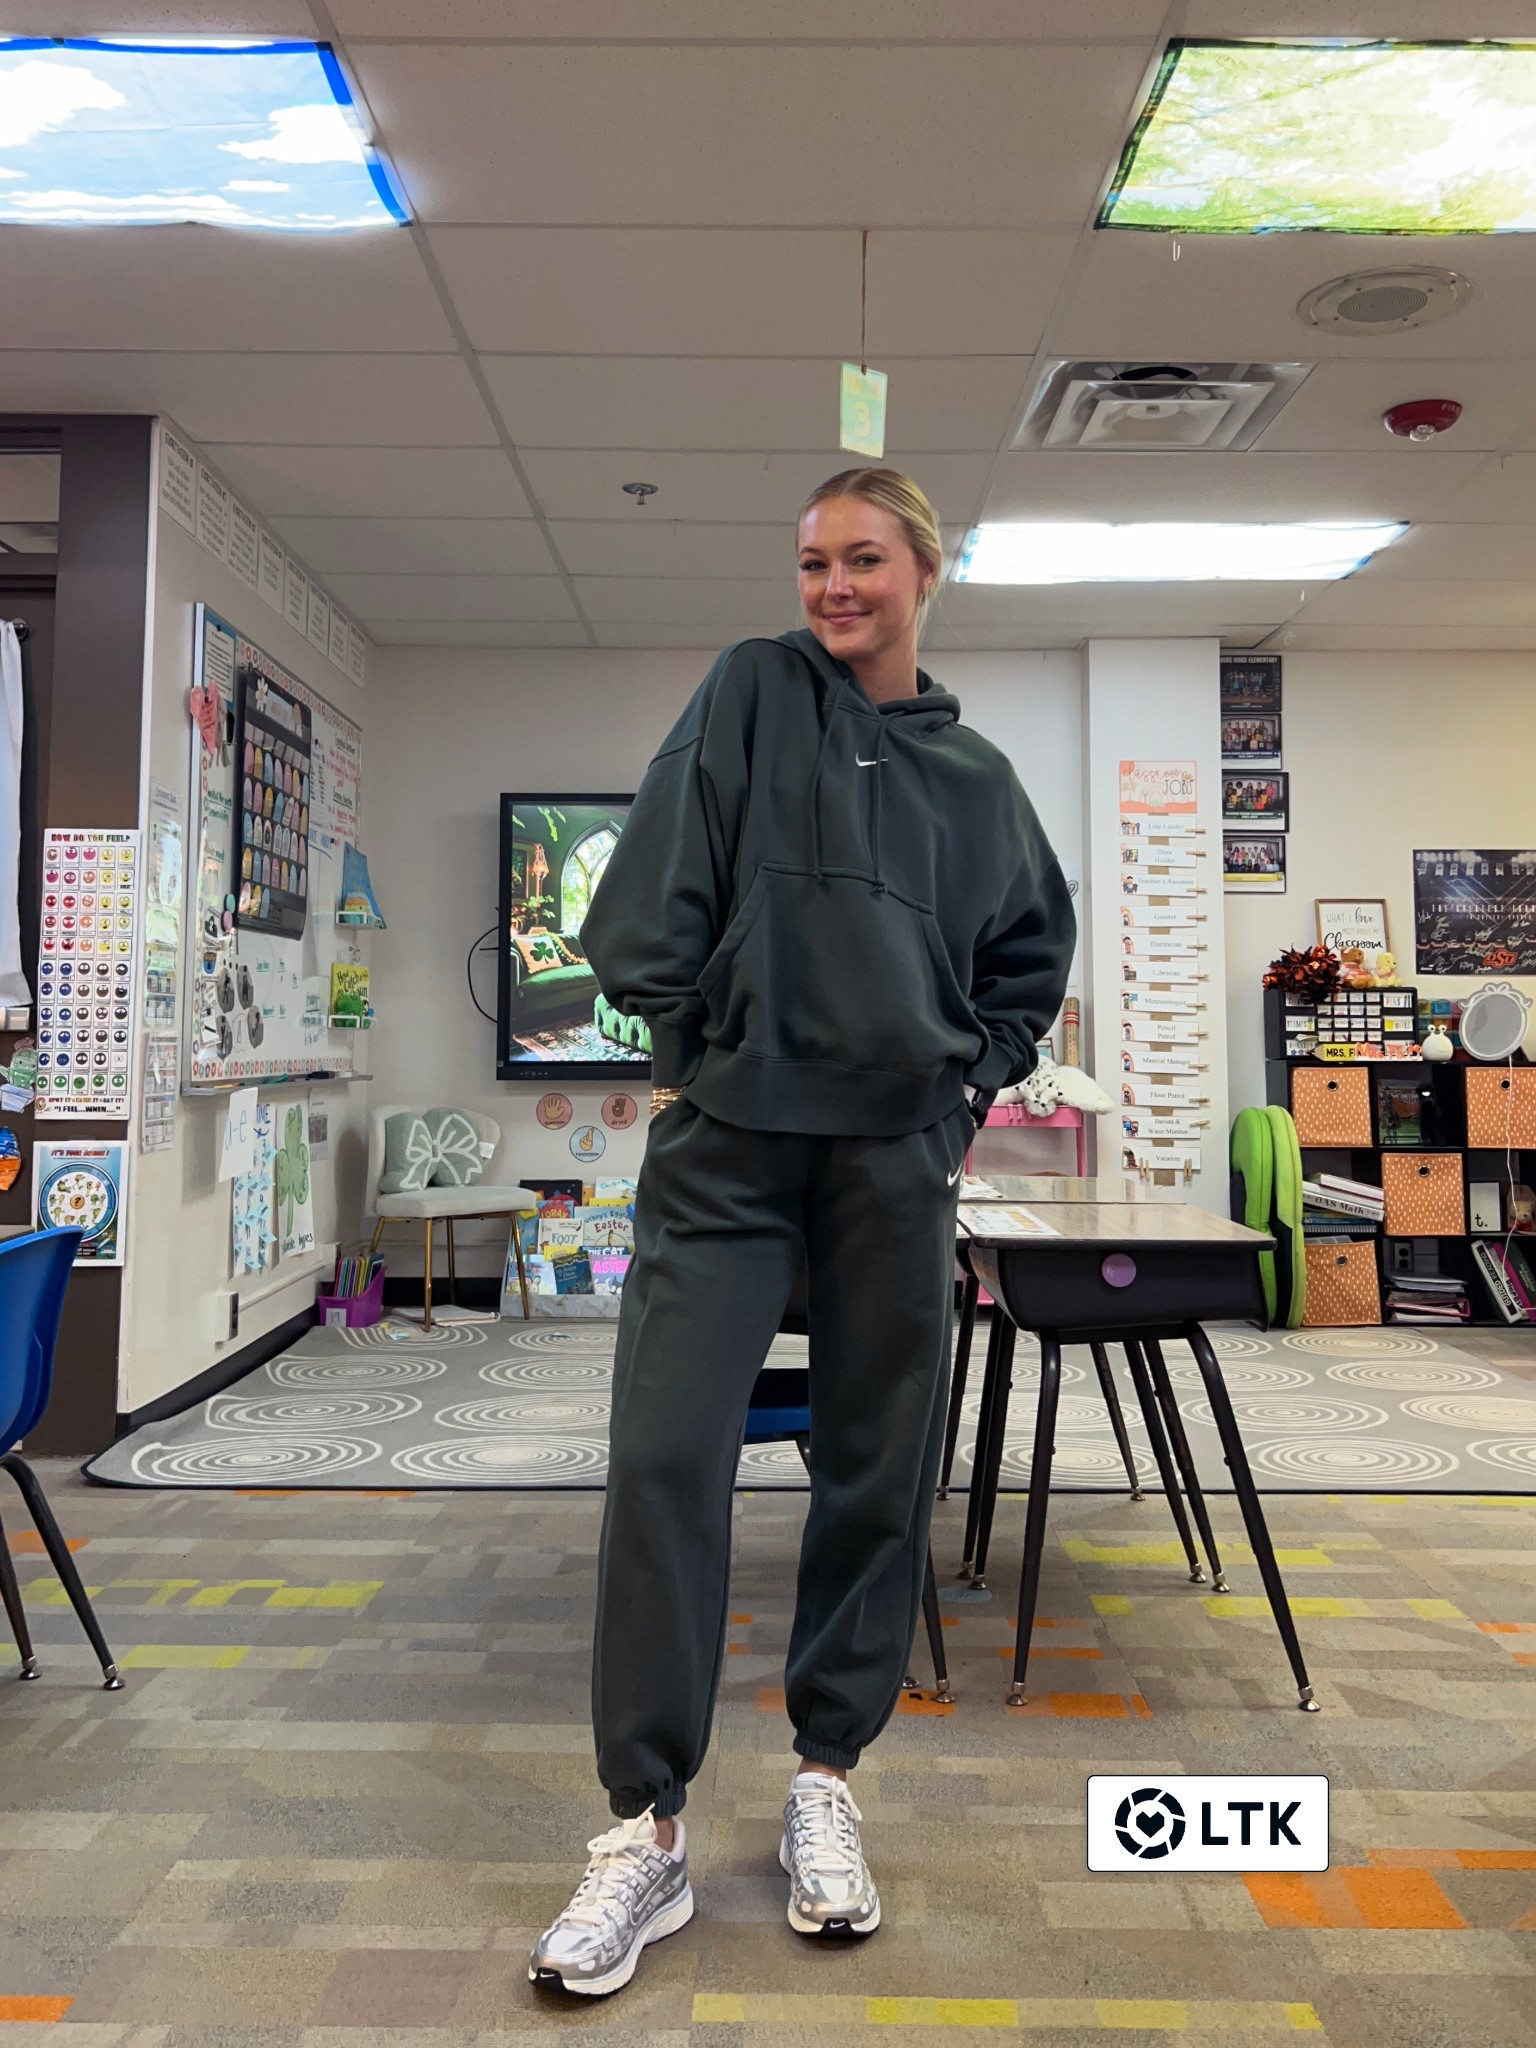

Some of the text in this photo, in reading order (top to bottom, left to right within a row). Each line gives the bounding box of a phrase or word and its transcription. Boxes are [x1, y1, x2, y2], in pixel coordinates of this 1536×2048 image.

[1162, 779, 1194, 795] JOBS
[51, 833, 131, 843] HOW DO YOU FEEL?
[1326, 913, 1345, 924] WHAT
[1355, 906, 1375, 925] love
[1324, 931, 1384, 951] Classroom
[1484, 949, 1518, 969] OSU
[1144, 997, 1186, 1006] Meteorologist
[1326, 1048, 1347, 1057] MRS.
[1315, 1196, 1337, 1208] OAS
[1340, 1202, 1364, 1215] Math
[584, 1213, 608, 1224] urkey's
[1474, 1213, 1488, 1228] t.
[594, 1219, 629, 1234] Easter
[298, 1232, 314, 1251] types
[552, 1233, 578, 1246] FOOT
[602, 1246, 625, 1256] CAT
[1480, 1251, 1512, 1307] GUIDED READING
[330, 1311, 340, 1323] 19
